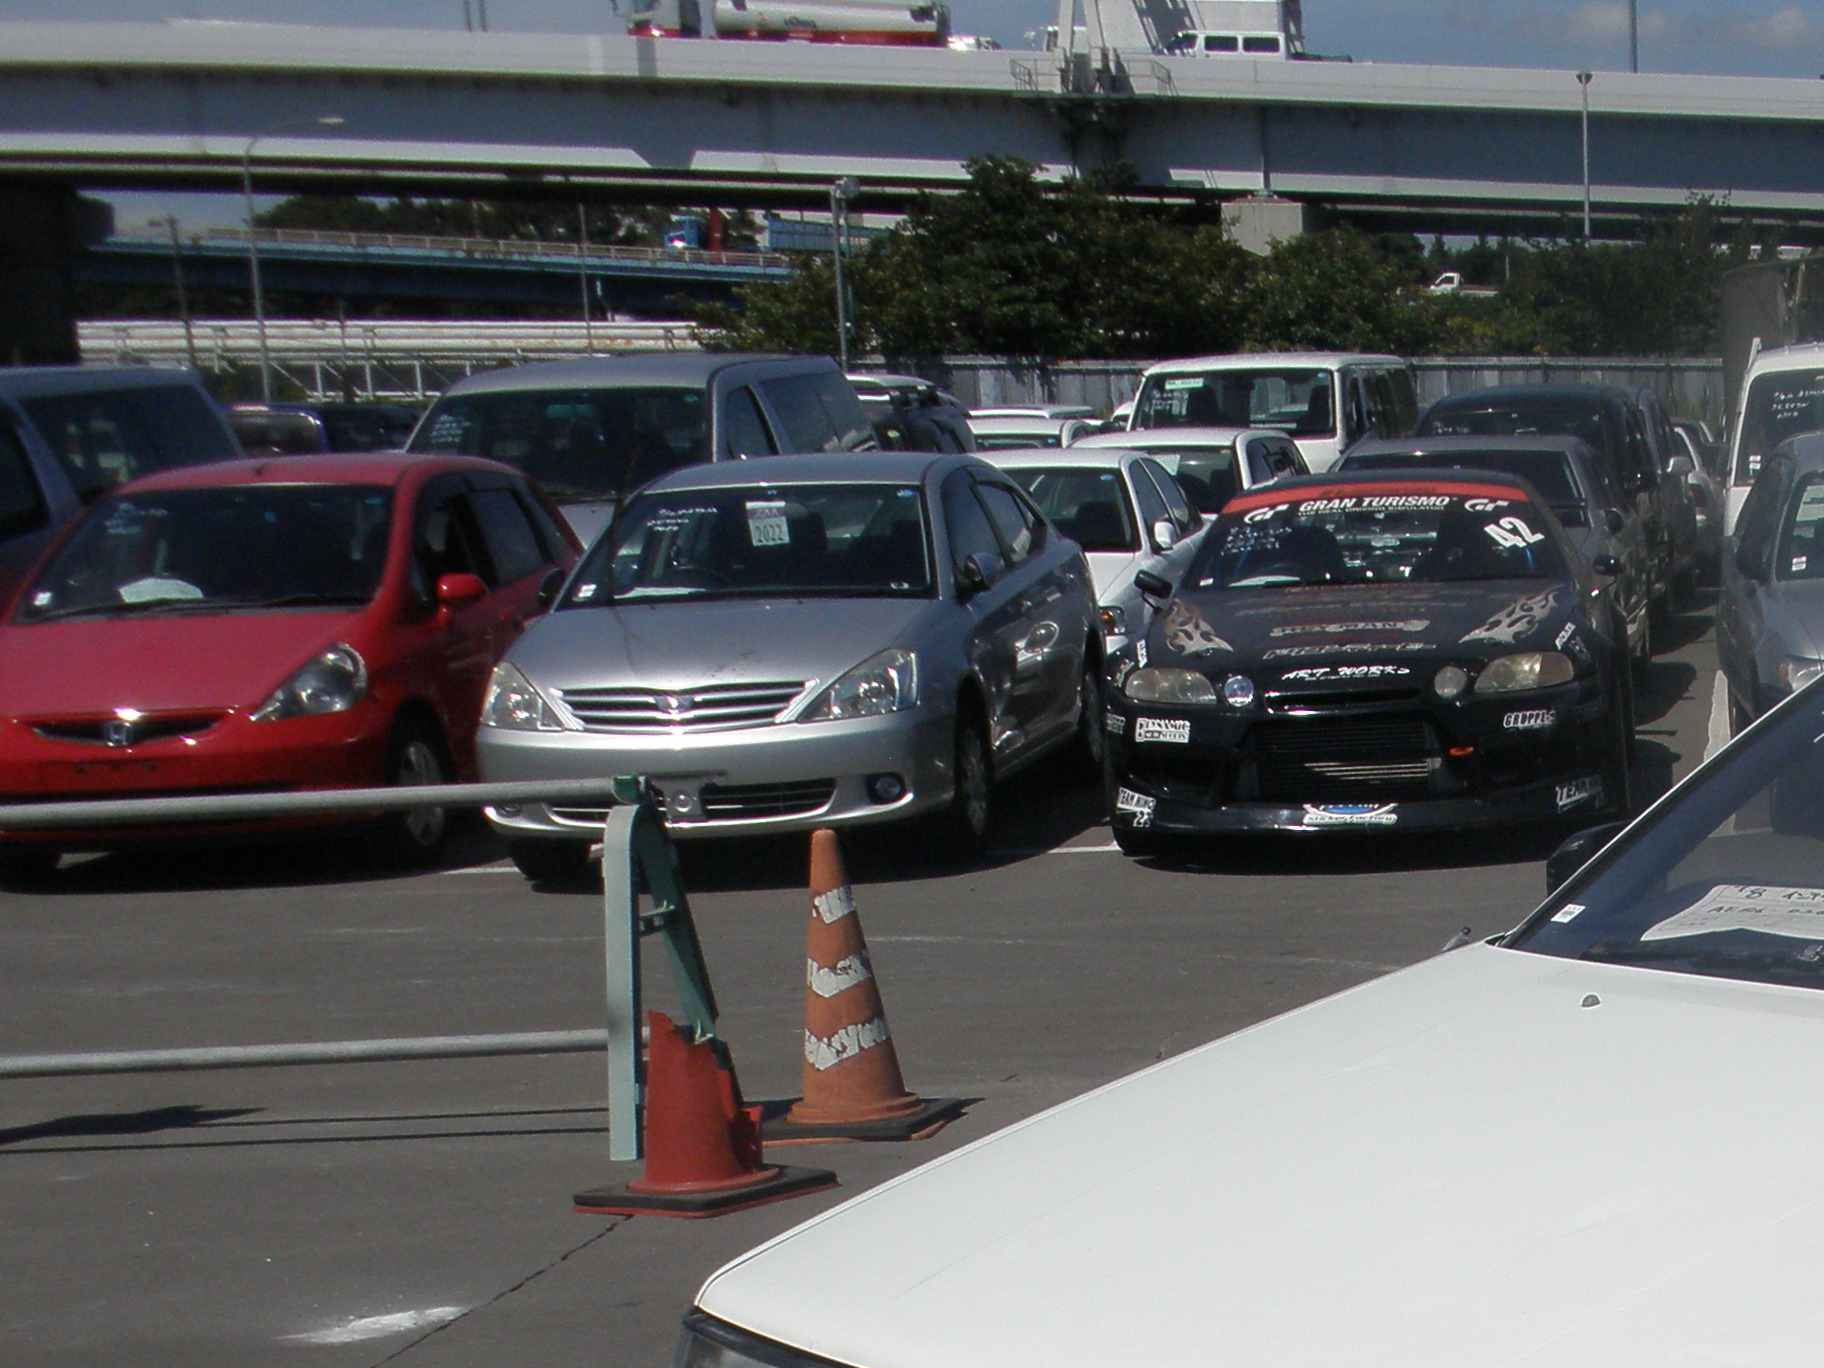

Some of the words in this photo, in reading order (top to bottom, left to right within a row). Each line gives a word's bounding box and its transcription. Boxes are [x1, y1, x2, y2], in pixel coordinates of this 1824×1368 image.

[1299, 498, 1357, 512] GRAN
[1361, 496, 1450, 508] TURISMO
[754, 522, 785, 543] 2022
[1484, 516, 1545, 548] 42
[1281, 667, 1330, 681] ART
[1337, 665, 1411, 676] WORKS
